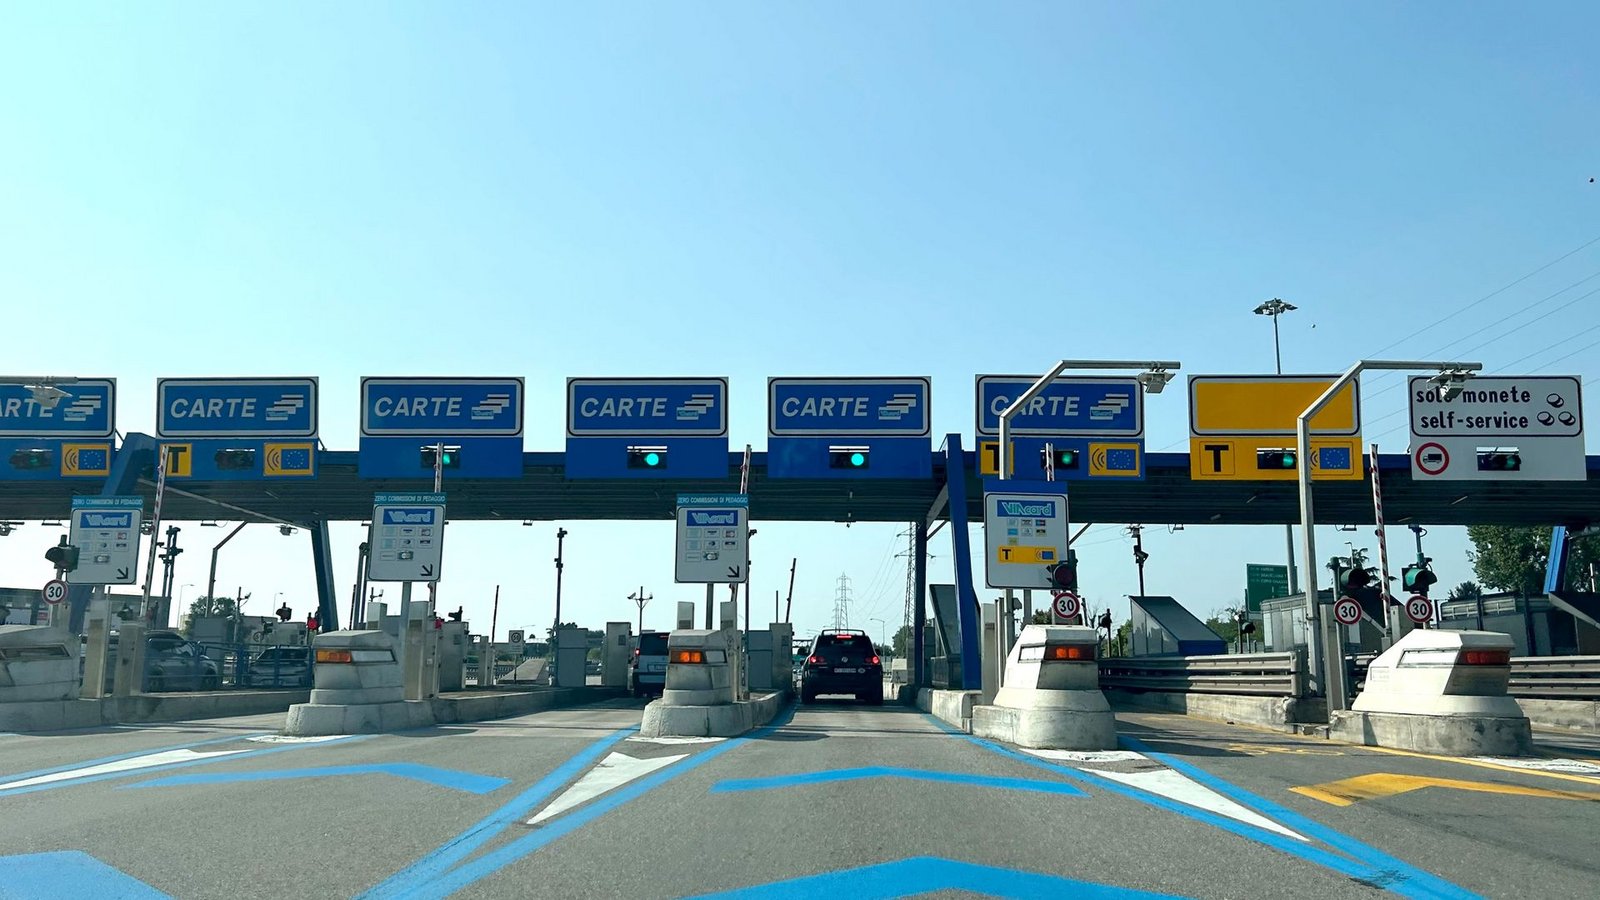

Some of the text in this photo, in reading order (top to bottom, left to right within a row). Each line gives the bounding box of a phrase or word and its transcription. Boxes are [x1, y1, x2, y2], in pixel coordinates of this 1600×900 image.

[1463, 386, 1531, 403] monete
[170, 398, 257, 418] CARTE
[374, 397, 462, 417] CARTE
[581, 397, 667, 417] CARTE
[782, 397, 869, 417] CARTE
[1421, 410, 1529, 429] self-service
[167, 446, 187, 474] T
[1204, 445, 1230, 472] T
[1002, 548, 1012, 561] T
[47, 586, 62, 599] 30
[1059, 599, 1075, 612] 30
[1340, 605, 1357, 618] 30
[1412, 602, 1428, 616] 30
